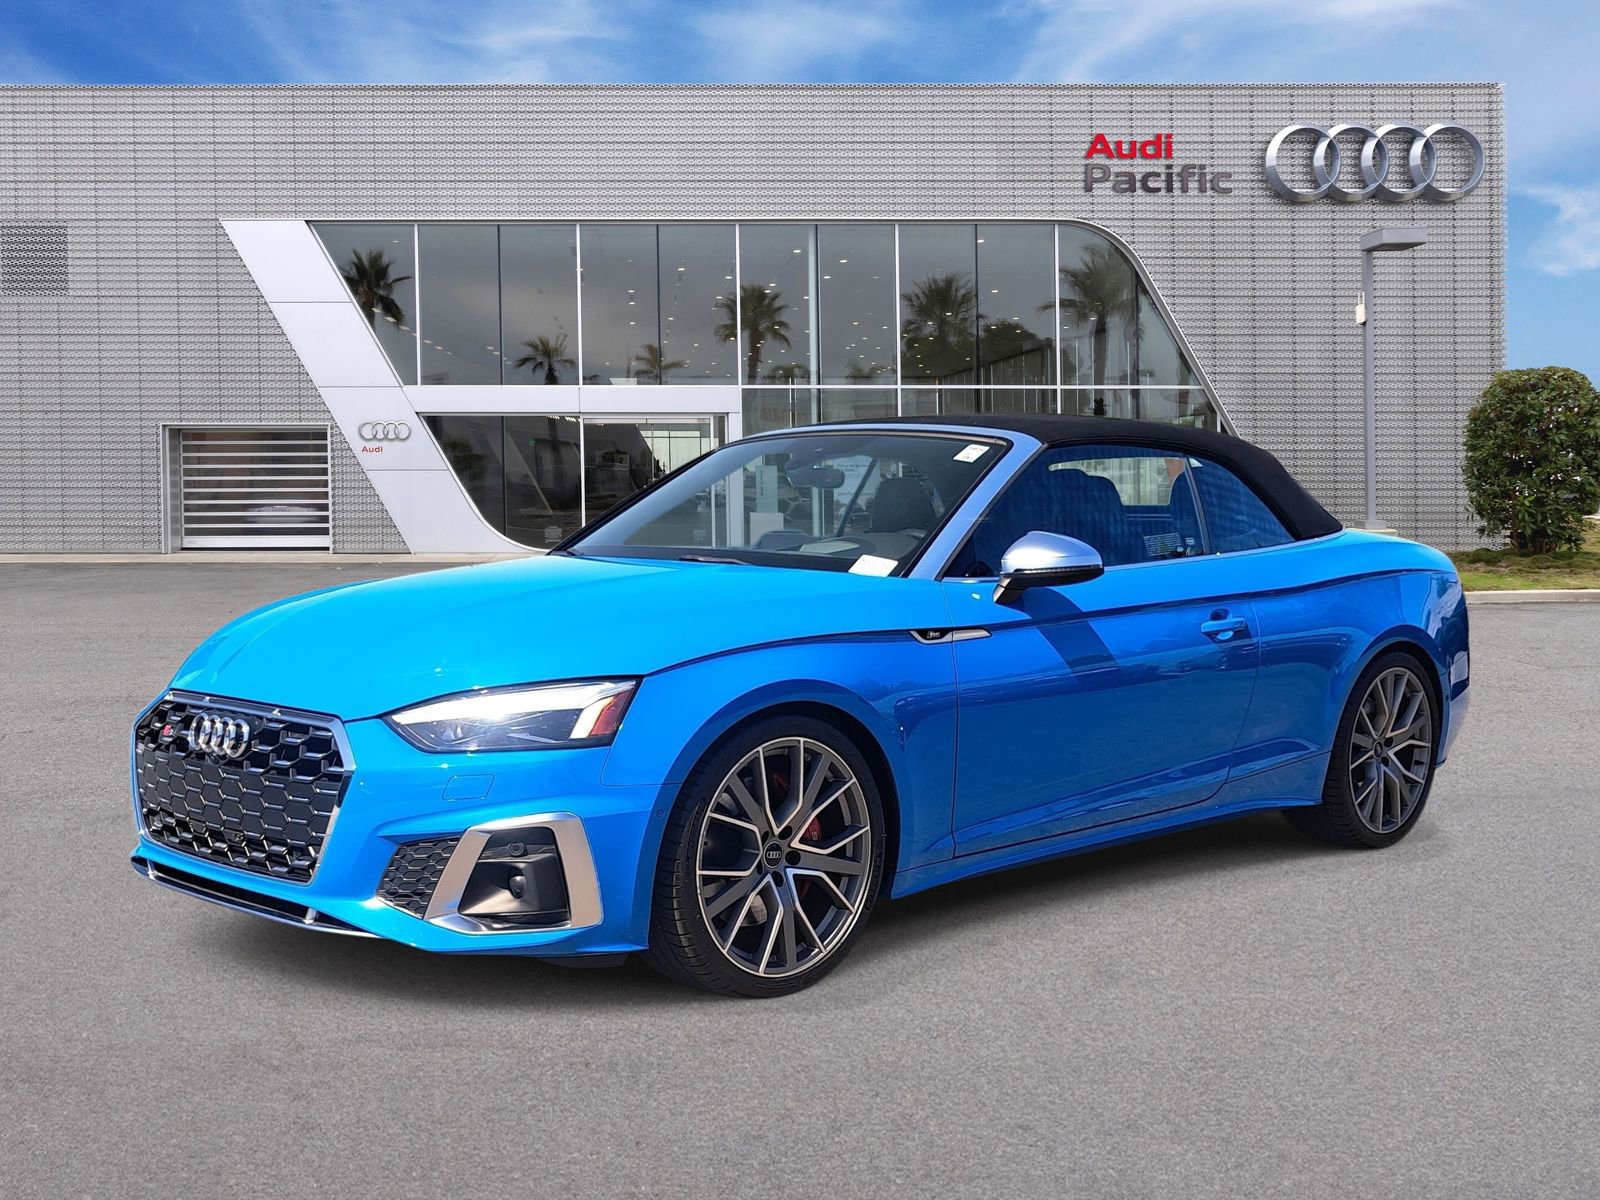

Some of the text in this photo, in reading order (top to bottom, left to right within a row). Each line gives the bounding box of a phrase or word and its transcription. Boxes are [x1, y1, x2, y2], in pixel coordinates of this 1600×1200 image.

[1085, 132, 1174, 159] Audi
[1084, 162, 1234, 194] Pacific
[361, 445, 383, 453] Audi
